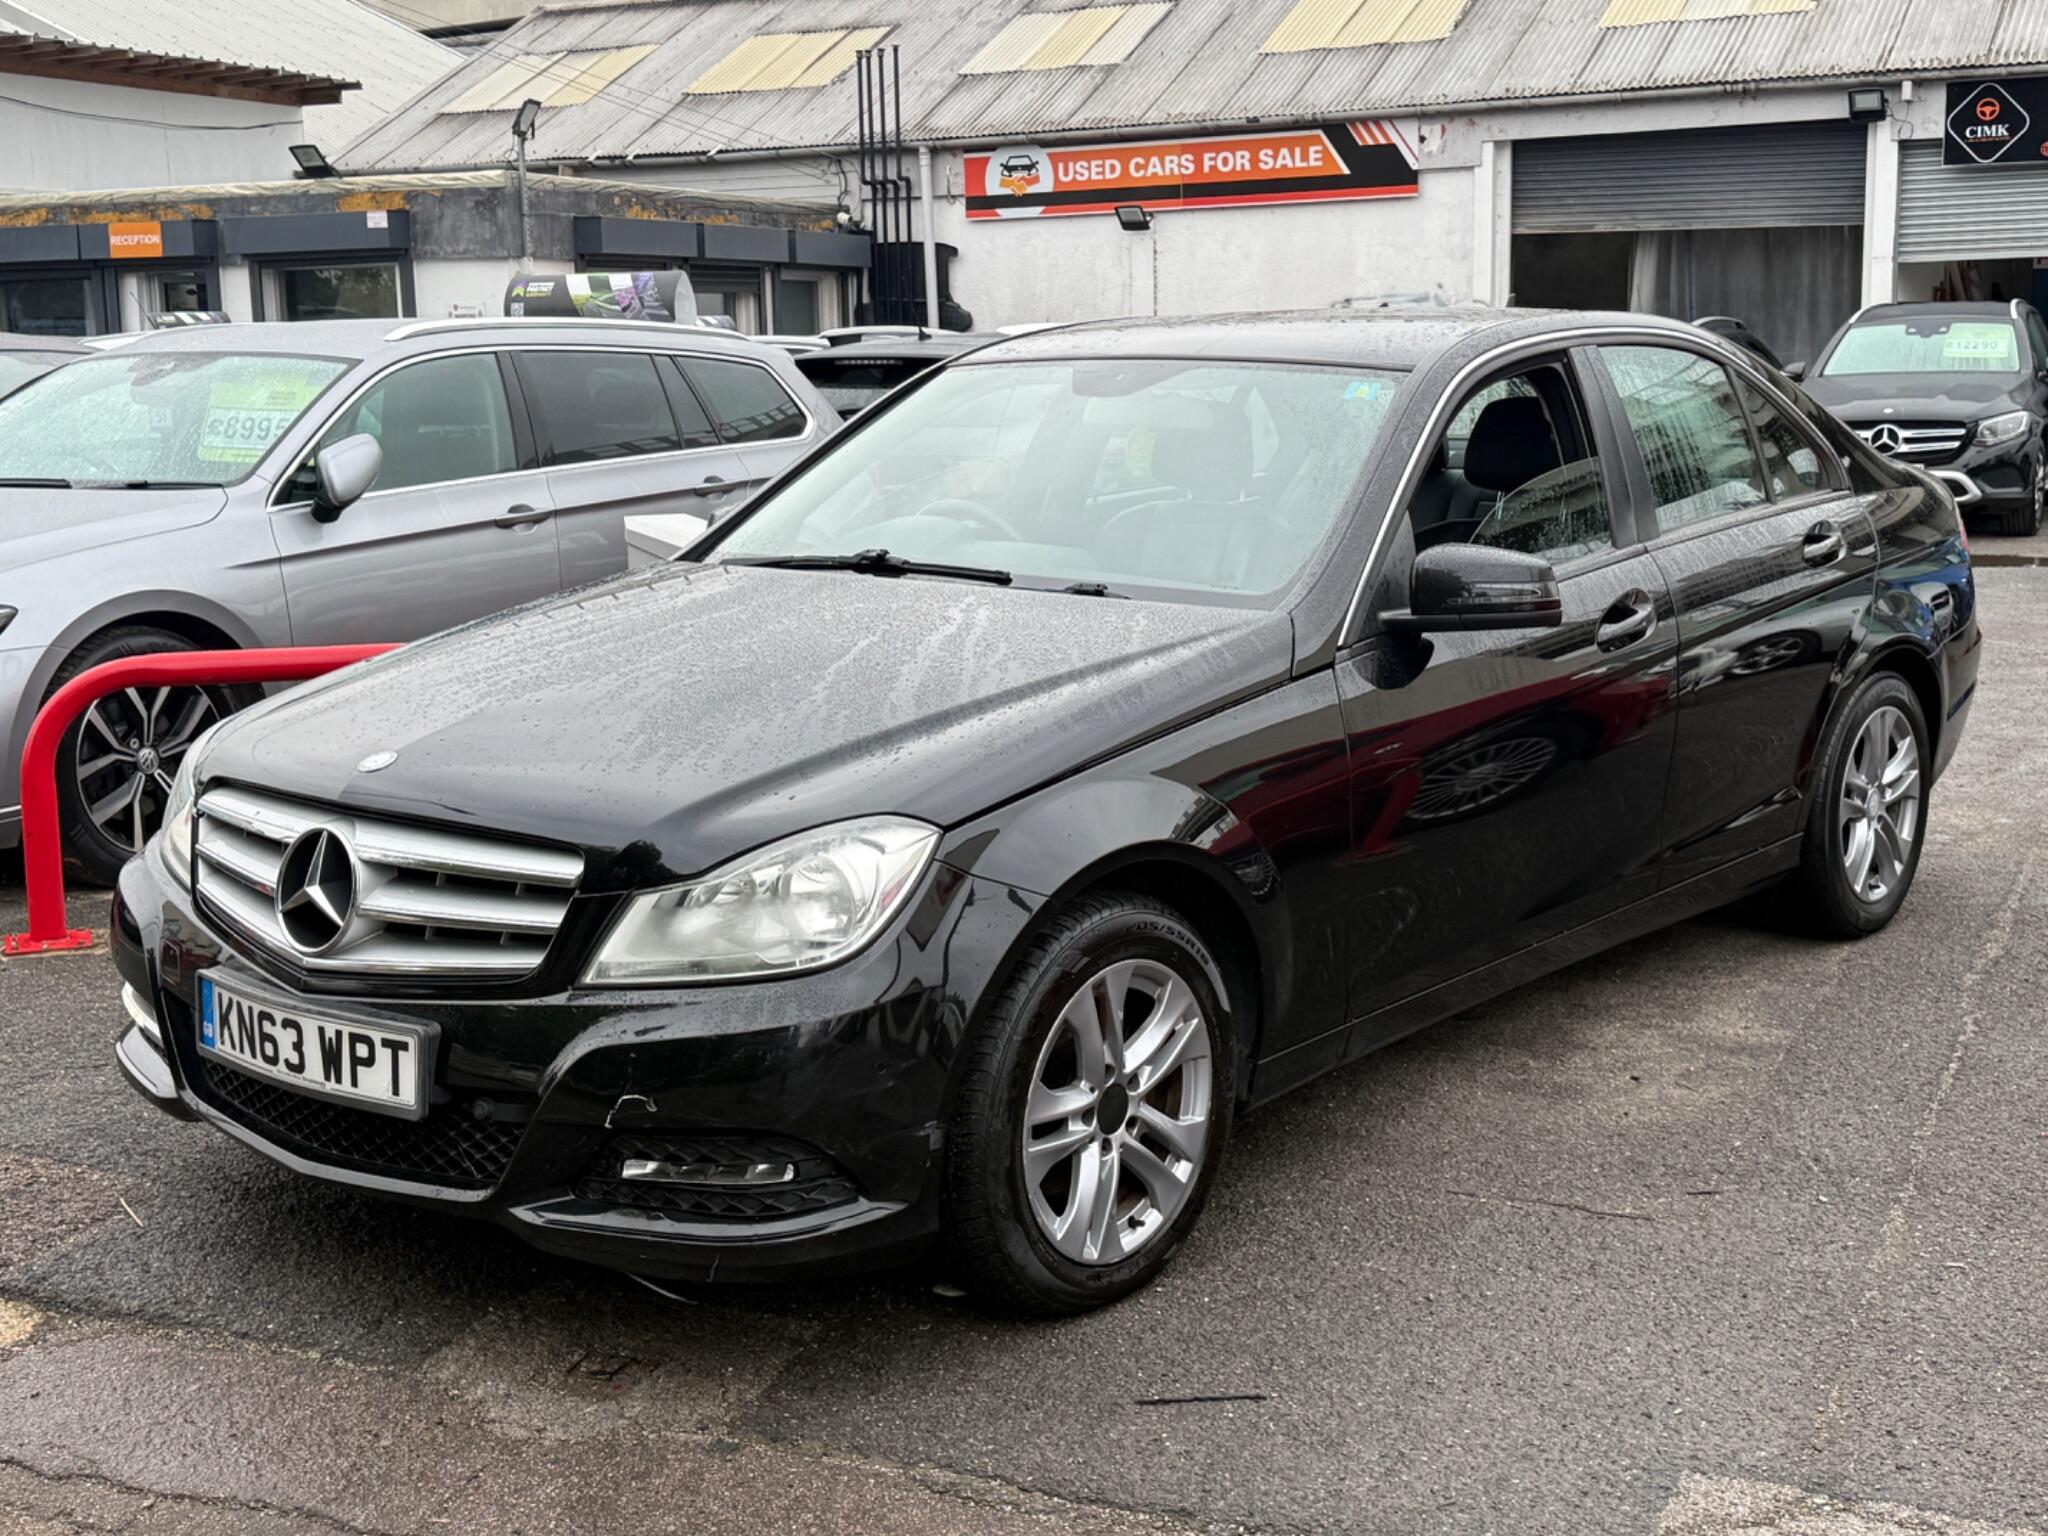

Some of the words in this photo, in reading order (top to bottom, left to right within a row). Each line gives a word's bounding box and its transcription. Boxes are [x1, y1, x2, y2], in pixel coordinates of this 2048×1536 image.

[1965, 124, 2010, 138] CIMK
[1057, 156, 1121, 183] USED
[1129, 152, 1195, 178] CARS
[1203, 150, 1250, 173] FOR
[1258, 145, 1324, 171] SALE
[111, 234, 161, 246] RECEPTION
[217, 991, 306, 1075] KN63
[317, 1024, 410, 1098] WPT
